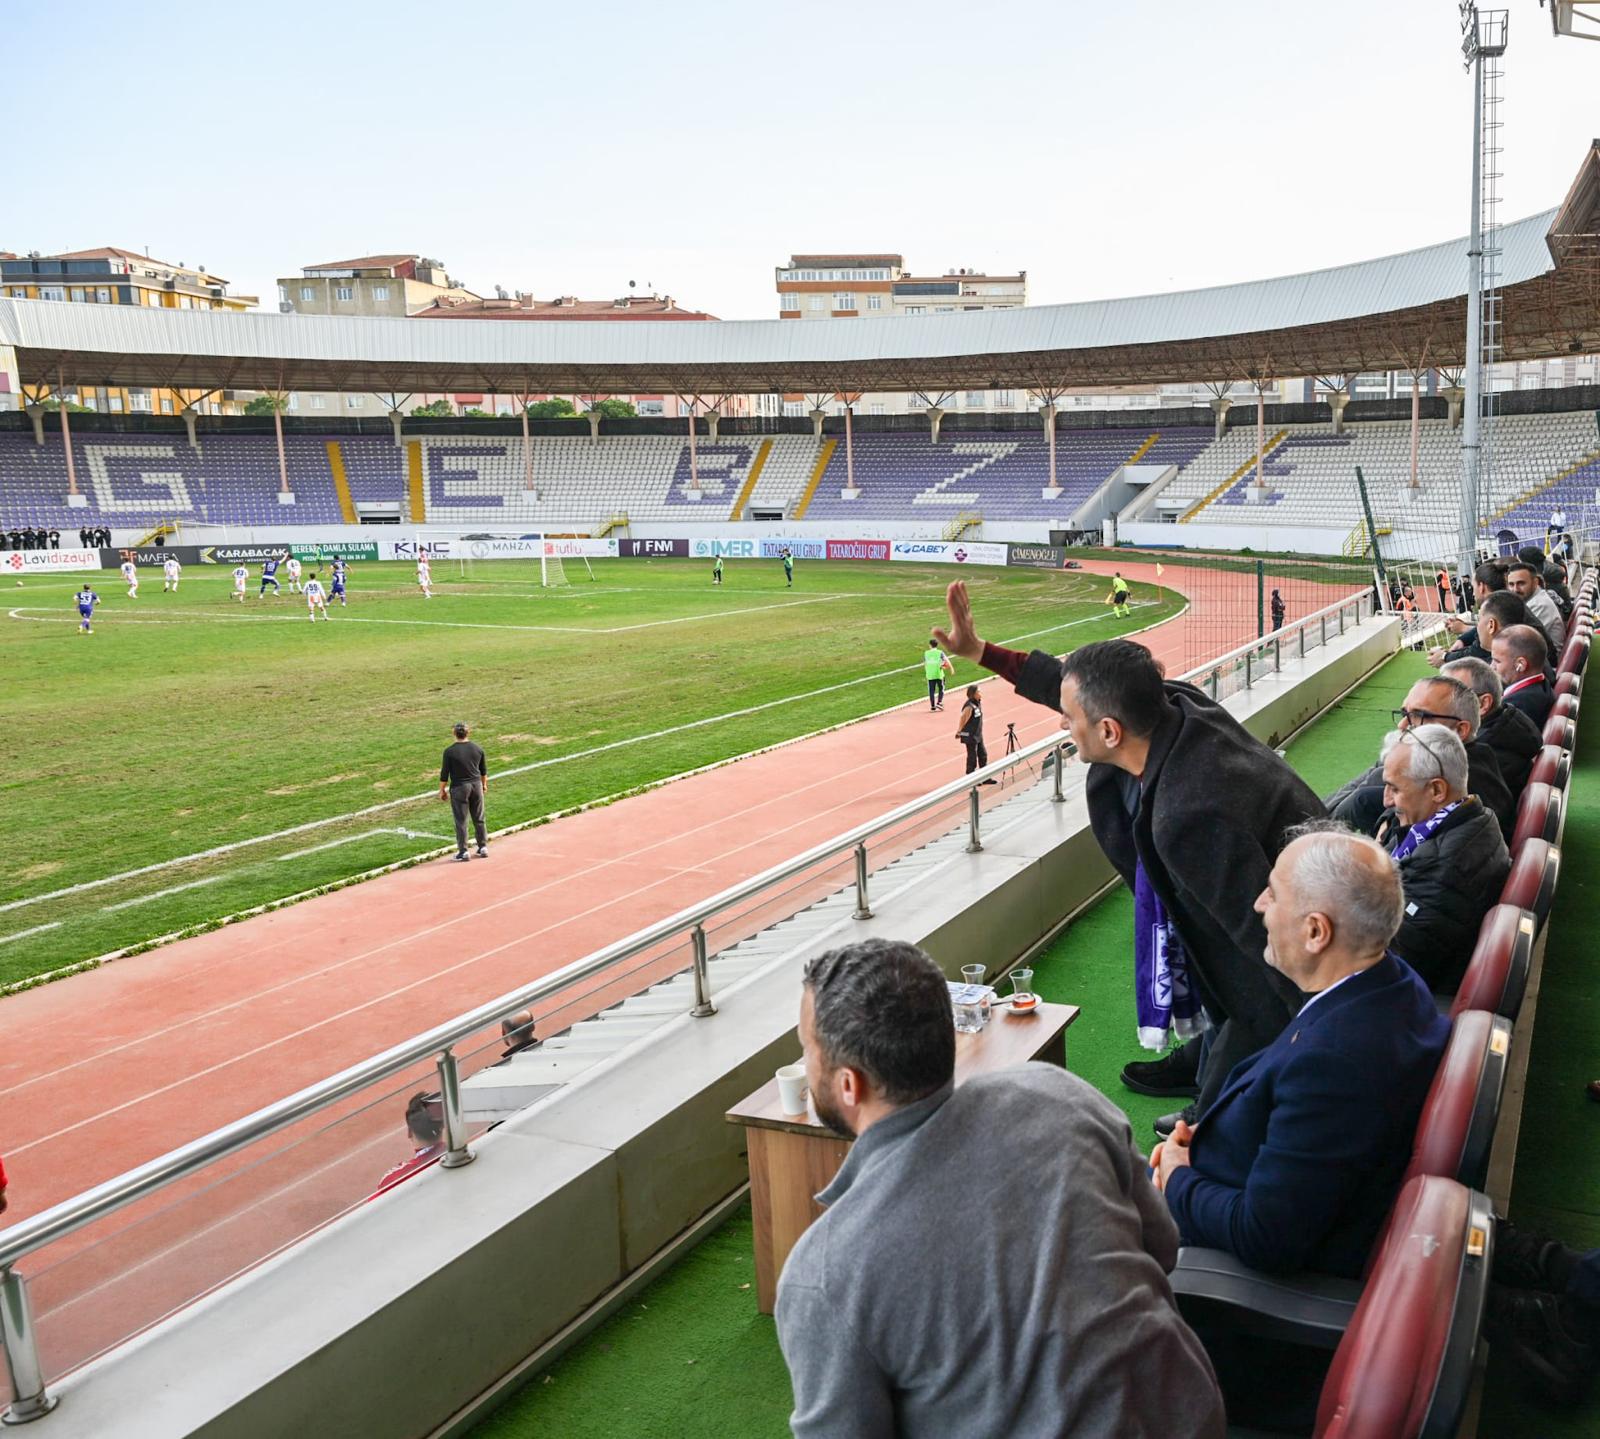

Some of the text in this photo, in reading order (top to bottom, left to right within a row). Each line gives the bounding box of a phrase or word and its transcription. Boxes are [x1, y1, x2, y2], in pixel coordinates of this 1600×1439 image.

[216, 548, 287, 558] KARABACAK
[323, 544, 348, 552] DAMLA
[347, 543, 376, 551] SULAMA
[645, 541, 673, 552] FNM
[711, 540, 754, 556] IMER
[803, 544, 823, 558] GRUP
[829, 541, 888, 559] TATAROĞLU GRUP
[23, 553, 95, 566] Lavidizayn
